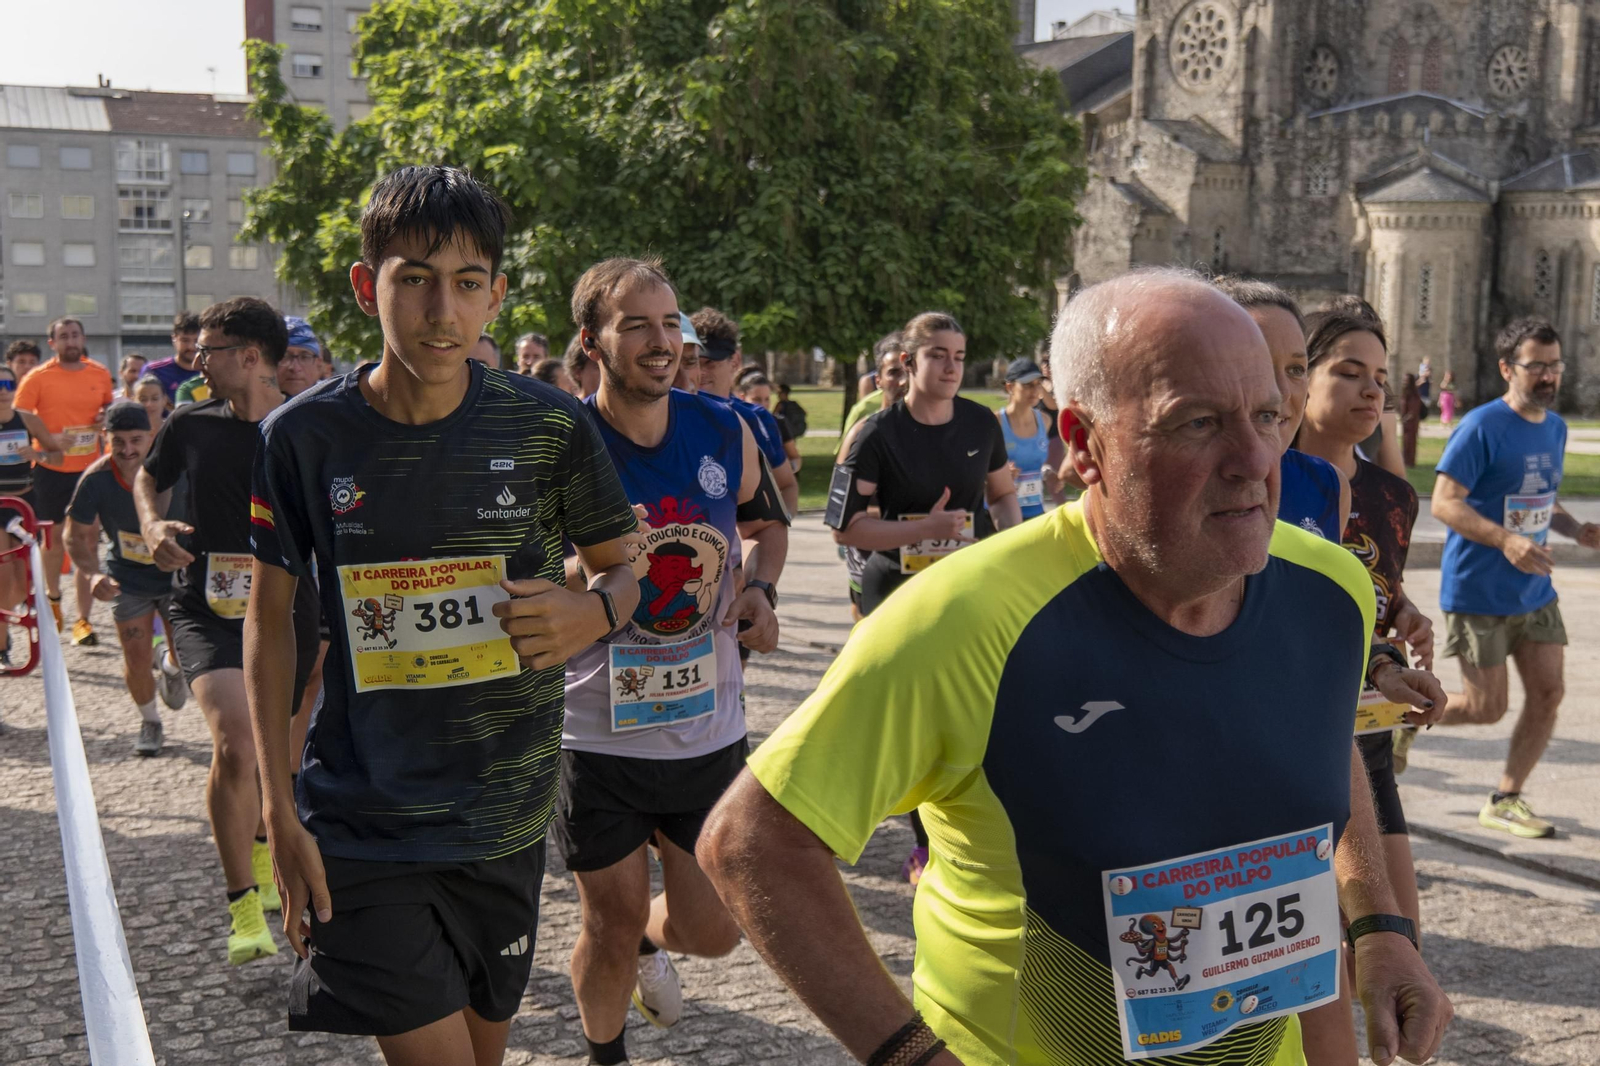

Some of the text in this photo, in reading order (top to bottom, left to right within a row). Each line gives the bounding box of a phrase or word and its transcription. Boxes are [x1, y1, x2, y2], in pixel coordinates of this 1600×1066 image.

[333, 475, 354, 484] mupol
[477, 507, 531, 519] Santander
[646, 526, 689, 545] TOUCIÑO
[691, 528, 698, 539] E
[352, 560, 493, 581] II CARREIRA POPULAR
[391, 575, 456, 591] DO PULPO
[413, 595, 484, 632] 381
[627, 645, 674, 655] CARREIRA
[676, 637, 707, 653] POPULAR
[646, 651, 690, 663] DO PULPO
[662, 664, 702, 690] 131
[1142, 856, 1234, 890] CARREIRA
[1237, 835, 1318, 869] POPULAR
[1183, 865, 1272, 899] DO PULPO
[1219, 893, 1305, 956] 125
[1202, 935, 1320, 978] GUILLERMO GUZMAN LORENZO
[1137, 988, 1148, 996] 687
[1250, 1001, 1278, 1014] OCCO
[1201, 1017, 1228, 1032] VITAMIN
[1202, 1027, 1217, 1037] WELL
[1137, 1030, 1182, 1046] GADIS
